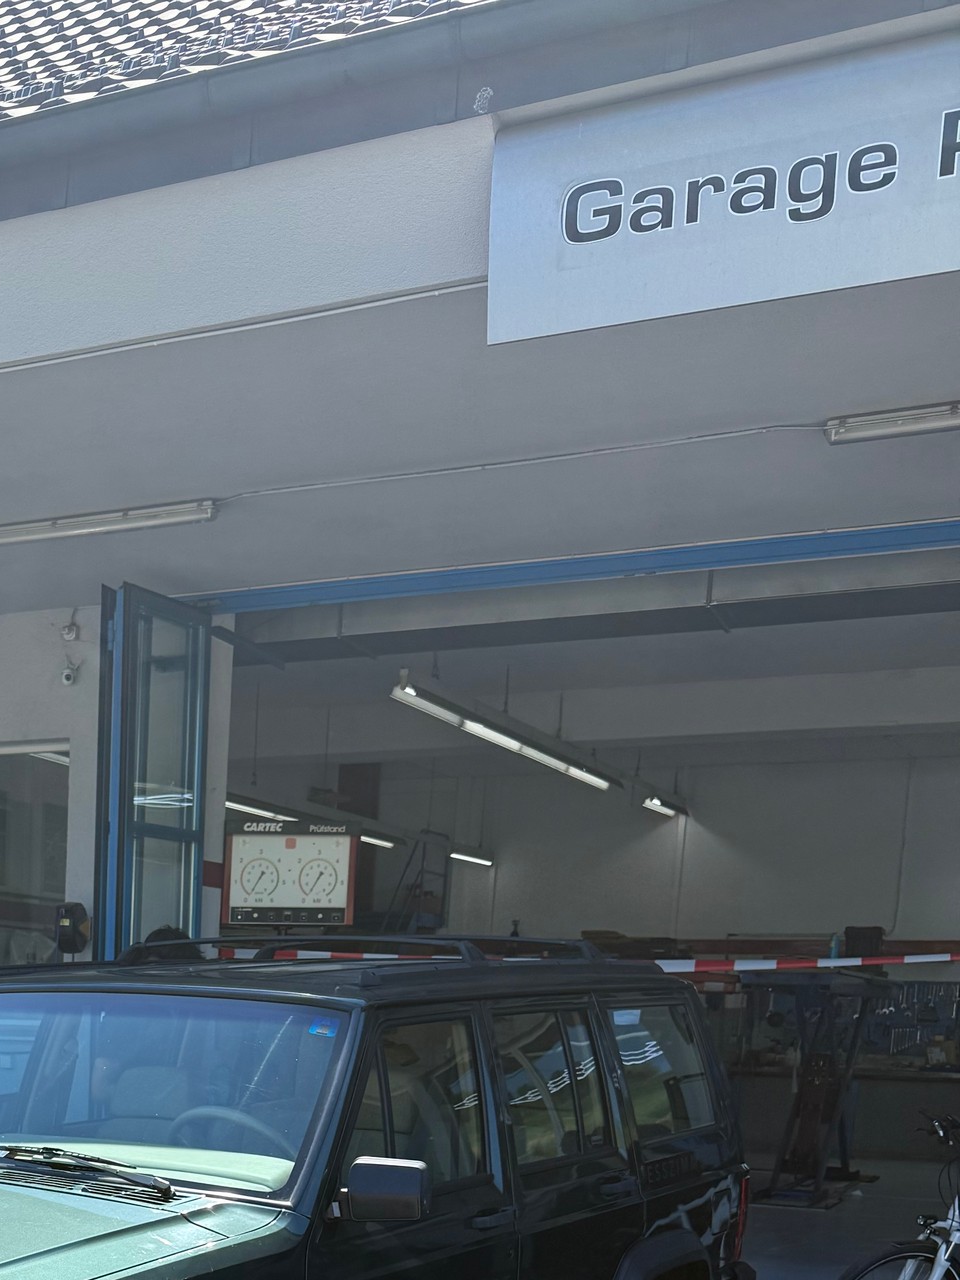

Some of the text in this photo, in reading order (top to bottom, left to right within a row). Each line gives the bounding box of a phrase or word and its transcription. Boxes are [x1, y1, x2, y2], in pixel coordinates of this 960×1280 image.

[562, 141, 900, 245] Garage
[243, 822, 283, 832] CARTEC
[309, 824, 346, 833] Prüfstand
